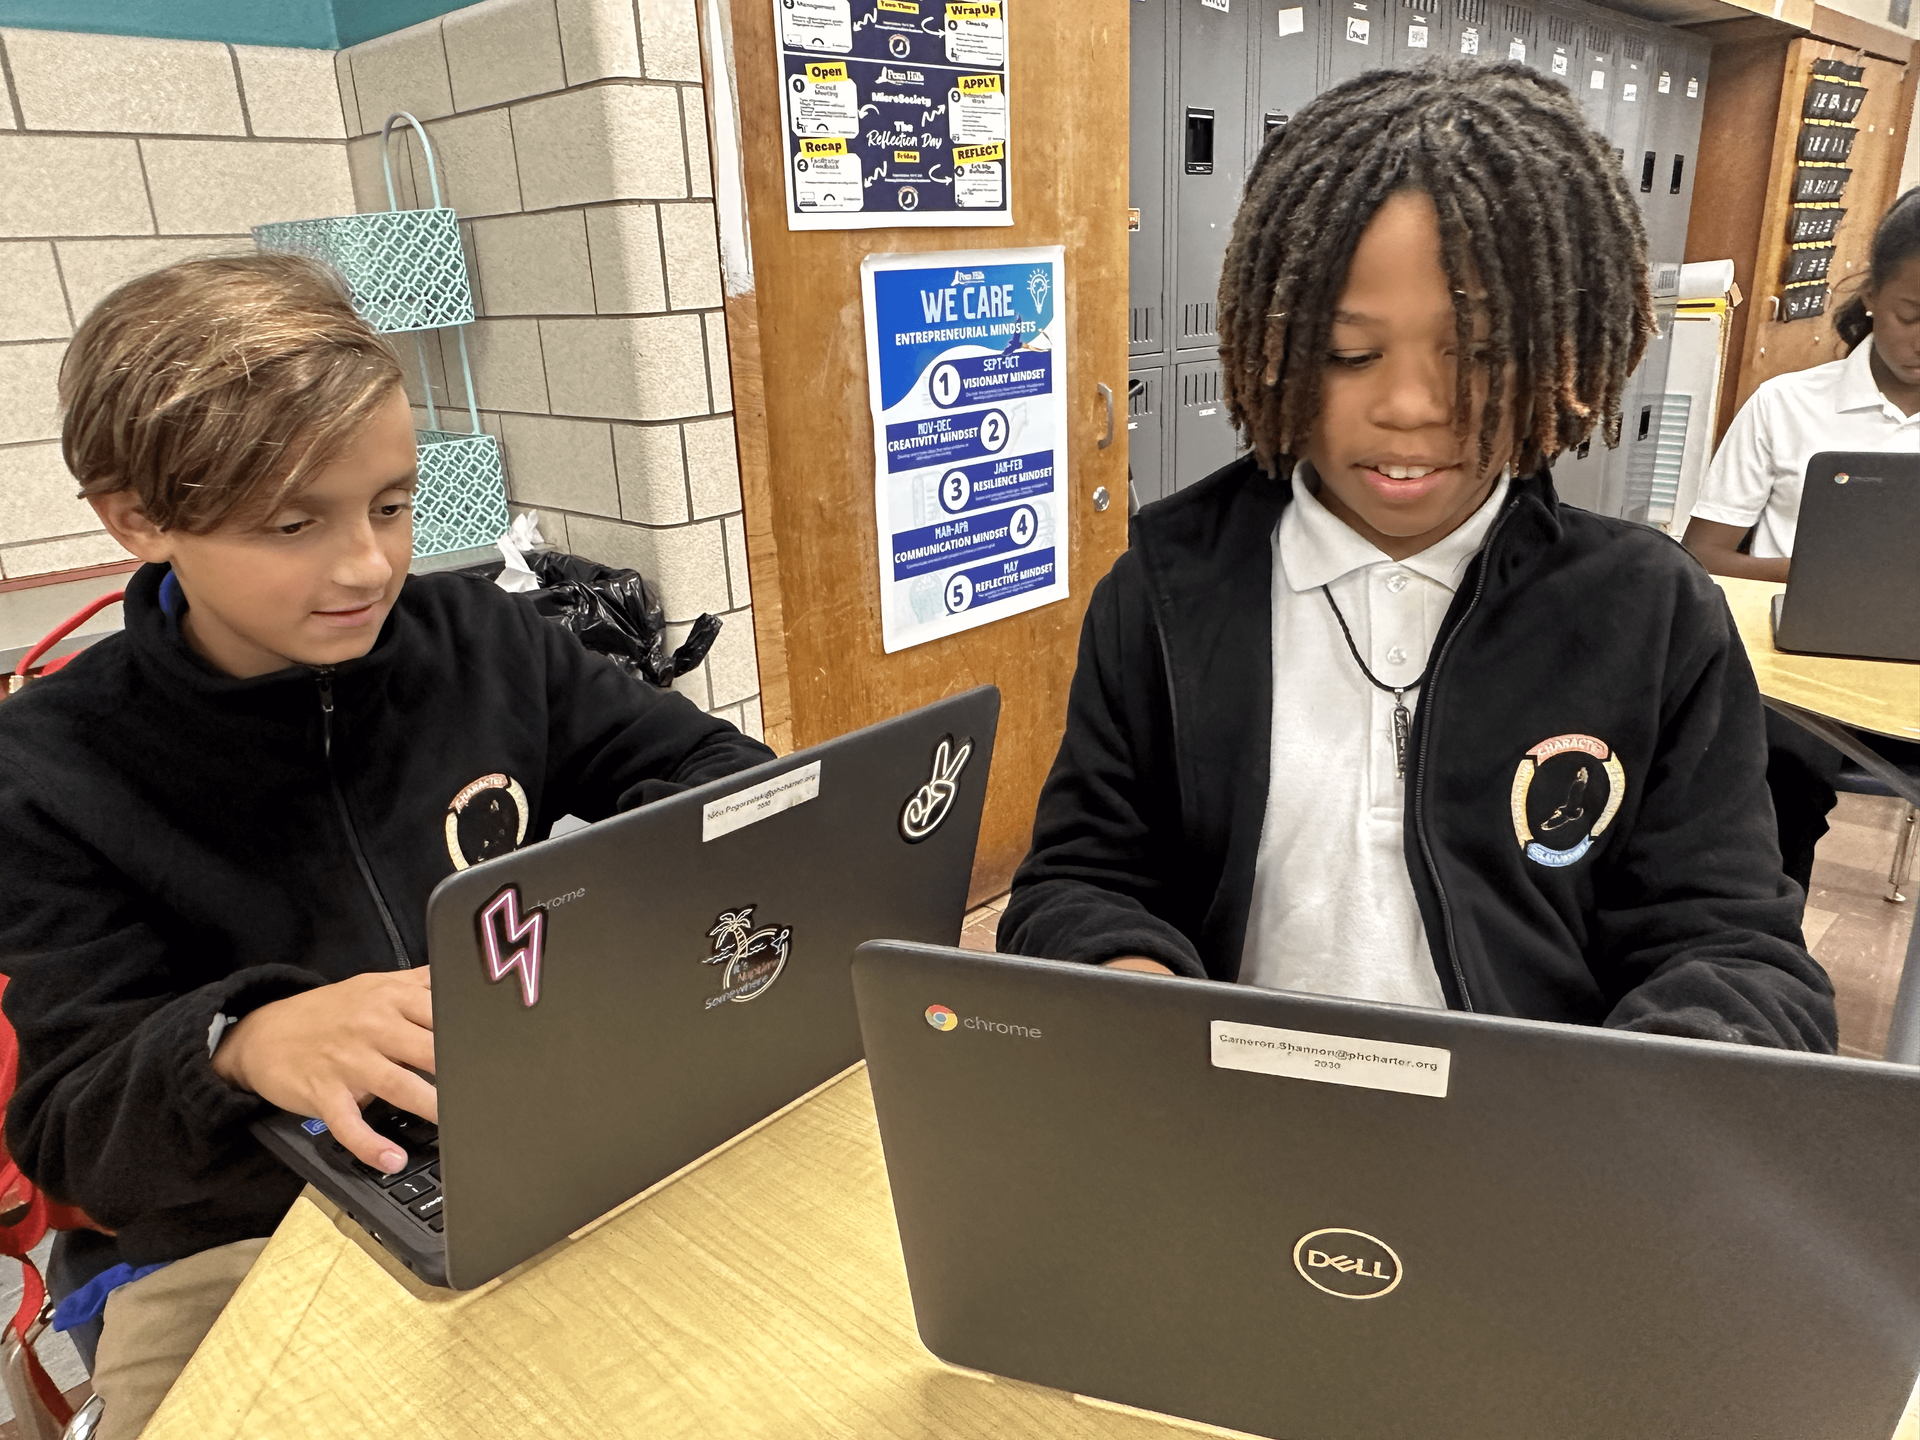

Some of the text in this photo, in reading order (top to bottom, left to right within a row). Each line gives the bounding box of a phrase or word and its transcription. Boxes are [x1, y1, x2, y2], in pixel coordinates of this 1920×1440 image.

[951, 5, 996, 18] Wrap Up
[812, 66, 842, 79] Open
[963, 77, 996, 89] APPLY
[894, 121, 914, 132] The
[805, 142, 842, 153] Recap
[866, 129, 942, 149] Reflection Day
[897, 153, 917, 161] Friday
[957, 145, 999, 160] REFLECT
[920, 284, 1015, 323] WE CARE
[895, 321, 1036, 346] ENTREPRENEURIAL MINDSETS
[983, 356, 1020, 371] SEPT-OCT
[939, 372, 949, 396] 1
[963, 368, 1045, 389] VISIONARY MINDSET
[918, 419, 951, 435] NOV-DEC
[988, 419, 1000, 442] 2
[888, 434, 939, 452] CREATIVITY
[940, 427, 978, 443] MINDSET
[994, 459, 1023, 475] JAN-FEB
[951, 478, 962, 501] 3
[973, 474, 1018, 492] RESILIENCE
[1019, 467, 1053, 482] MINDSET
[935, 521, 969, 539] MAR-APR
[1017, 514, 1028, 535] 4
[895, 536, 971, 563] COMMUNICATION
[973, 527, 1008, 544] MINDSET
[975, 572, 1019, 593] REFLECTIVE
[1020, 562, 1053, 580] MINDSET
[1004, 560, 1019, 574] MAY
[953, 584, 964, 607] 5
[705, 975, 769, 1010] Somewhere
[964, 1016, 1042, 1038] chrome
[1314, 1059, 1341, 1070] 2030
[1308, 1249, 1391, 1280] DELL
